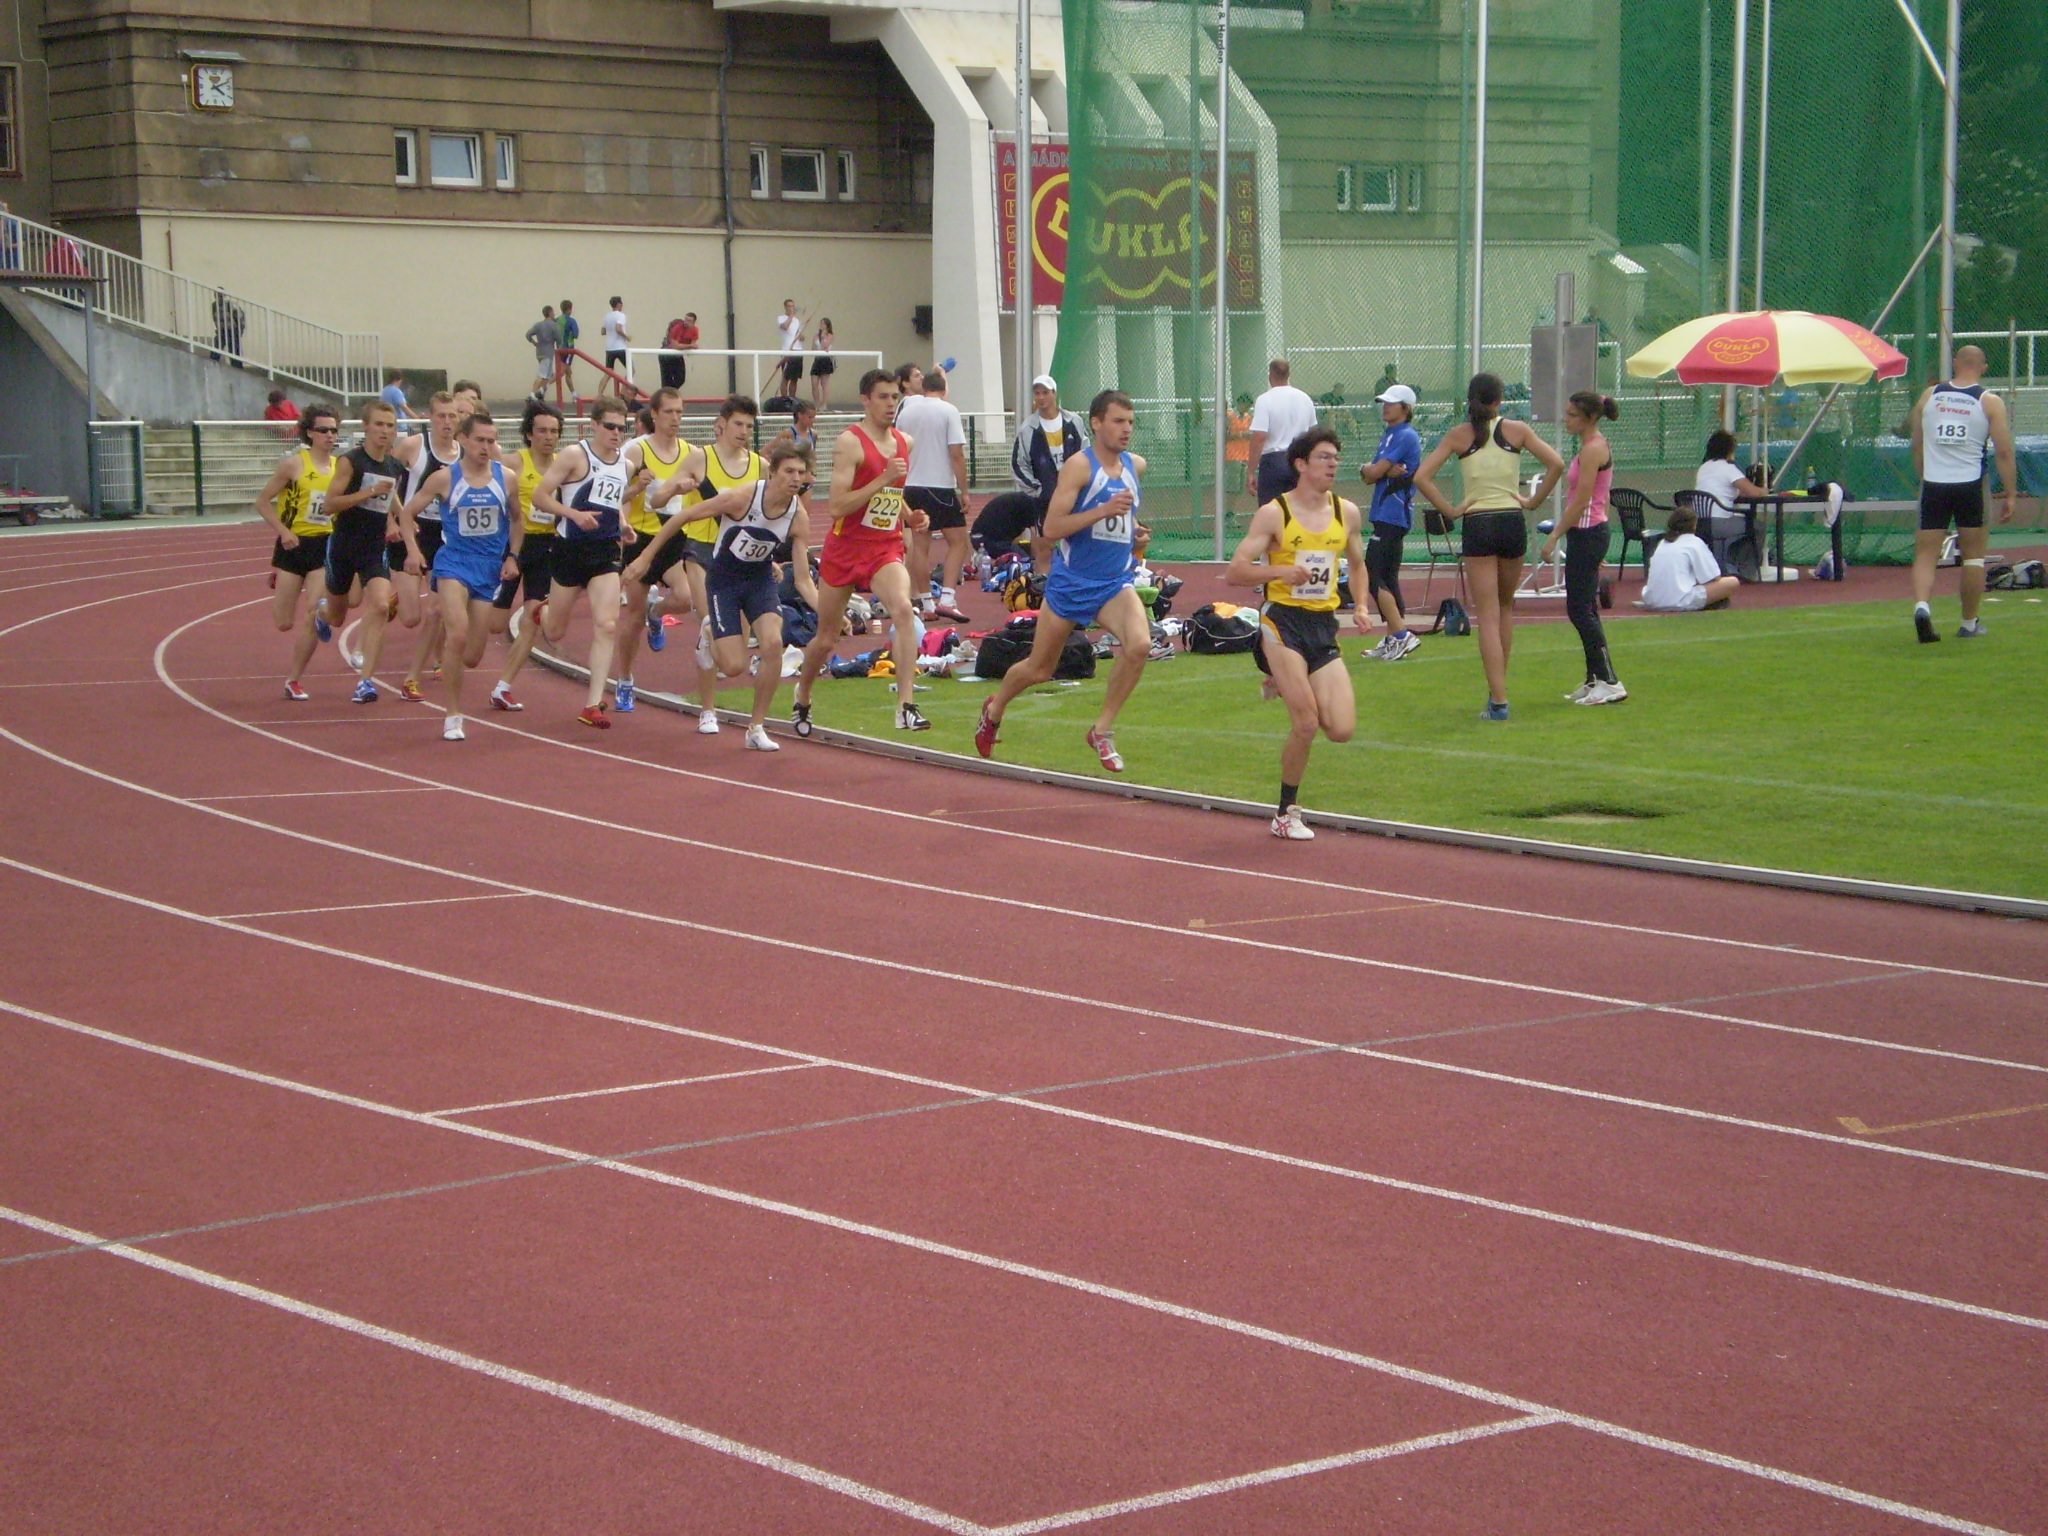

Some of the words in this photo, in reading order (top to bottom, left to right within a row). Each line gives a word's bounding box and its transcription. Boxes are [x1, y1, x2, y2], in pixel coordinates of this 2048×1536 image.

[1713, 340, 1761, 351] DUKLA
[1939, 406, 1972, 416] SYNER
[1936, 424, 1967, 438] 183
[597, 480, 622, 503] 124
[869, 496, 900, 516] 222
[466, 507, 492, 530] 65
[738, 539, 768, 558] 130
